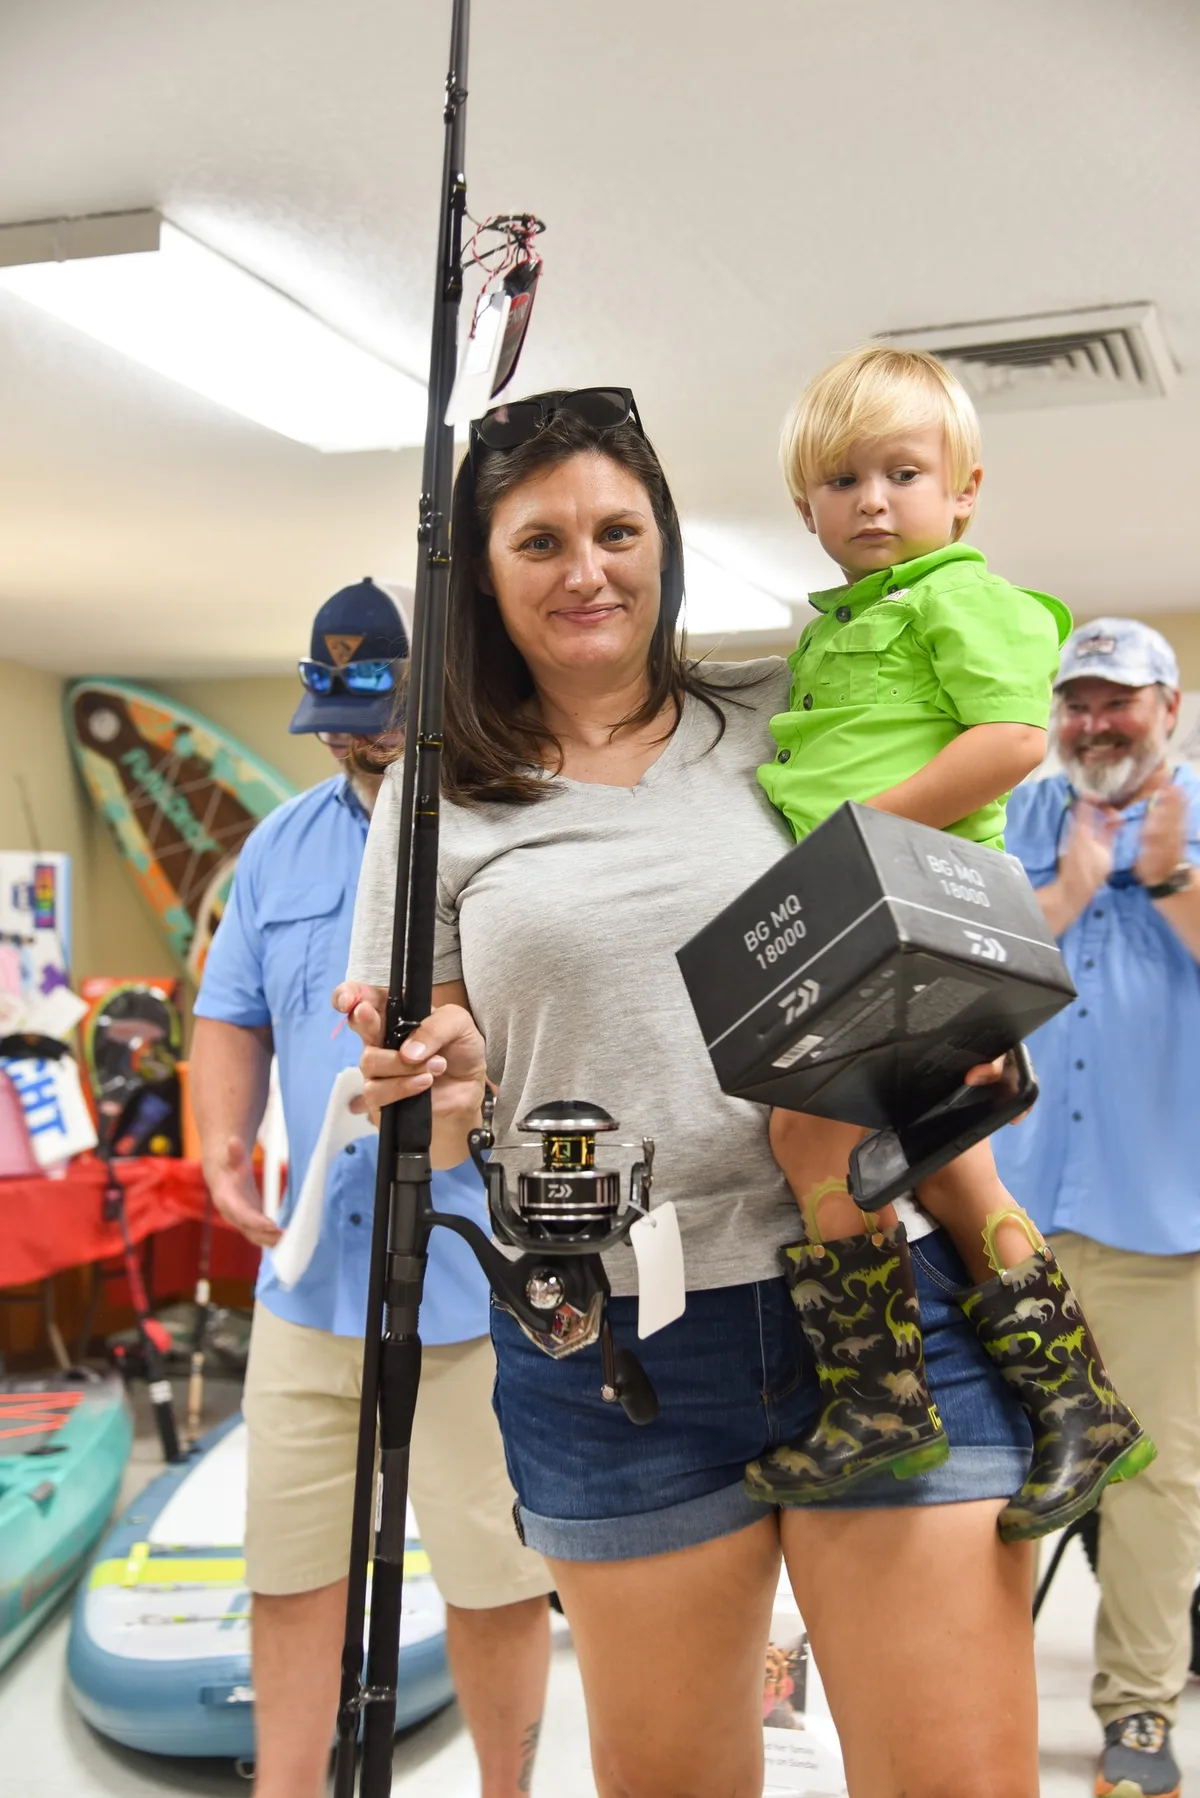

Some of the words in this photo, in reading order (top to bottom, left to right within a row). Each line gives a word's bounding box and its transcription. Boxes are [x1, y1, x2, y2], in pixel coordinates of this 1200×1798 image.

[926, 854, 954, 877] BG
[940, 879, 991, 908] 18000
[743, 920, 770, 952] BG
[770, 894, 802, 929] MQ
[756, 919, 807, 970] 18000
